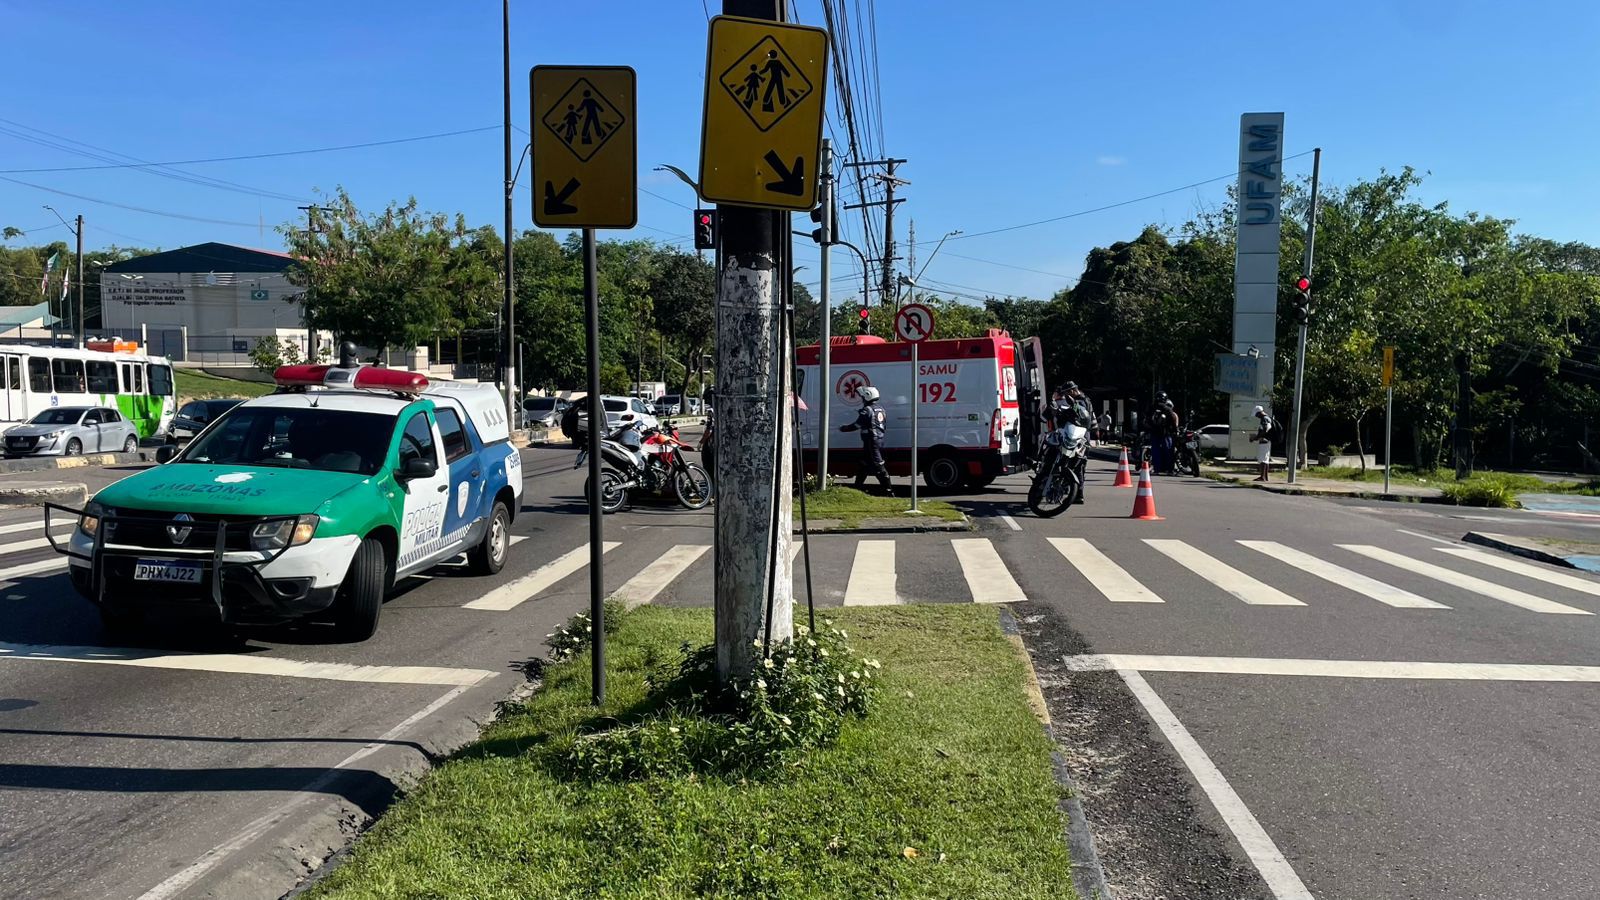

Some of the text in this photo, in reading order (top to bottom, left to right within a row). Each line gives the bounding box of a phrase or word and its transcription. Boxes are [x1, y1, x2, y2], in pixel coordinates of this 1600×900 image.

[1246, 124, 1278, 225] UFAM
[919, 364, 957, 376] SAMU
[919, 382, 957, 403] 192
[150, 483, 266, 497] AMAZONAS
[415, 526, 439, 546] MILITAR
[140, 565, 195, 581] PHX4J22
